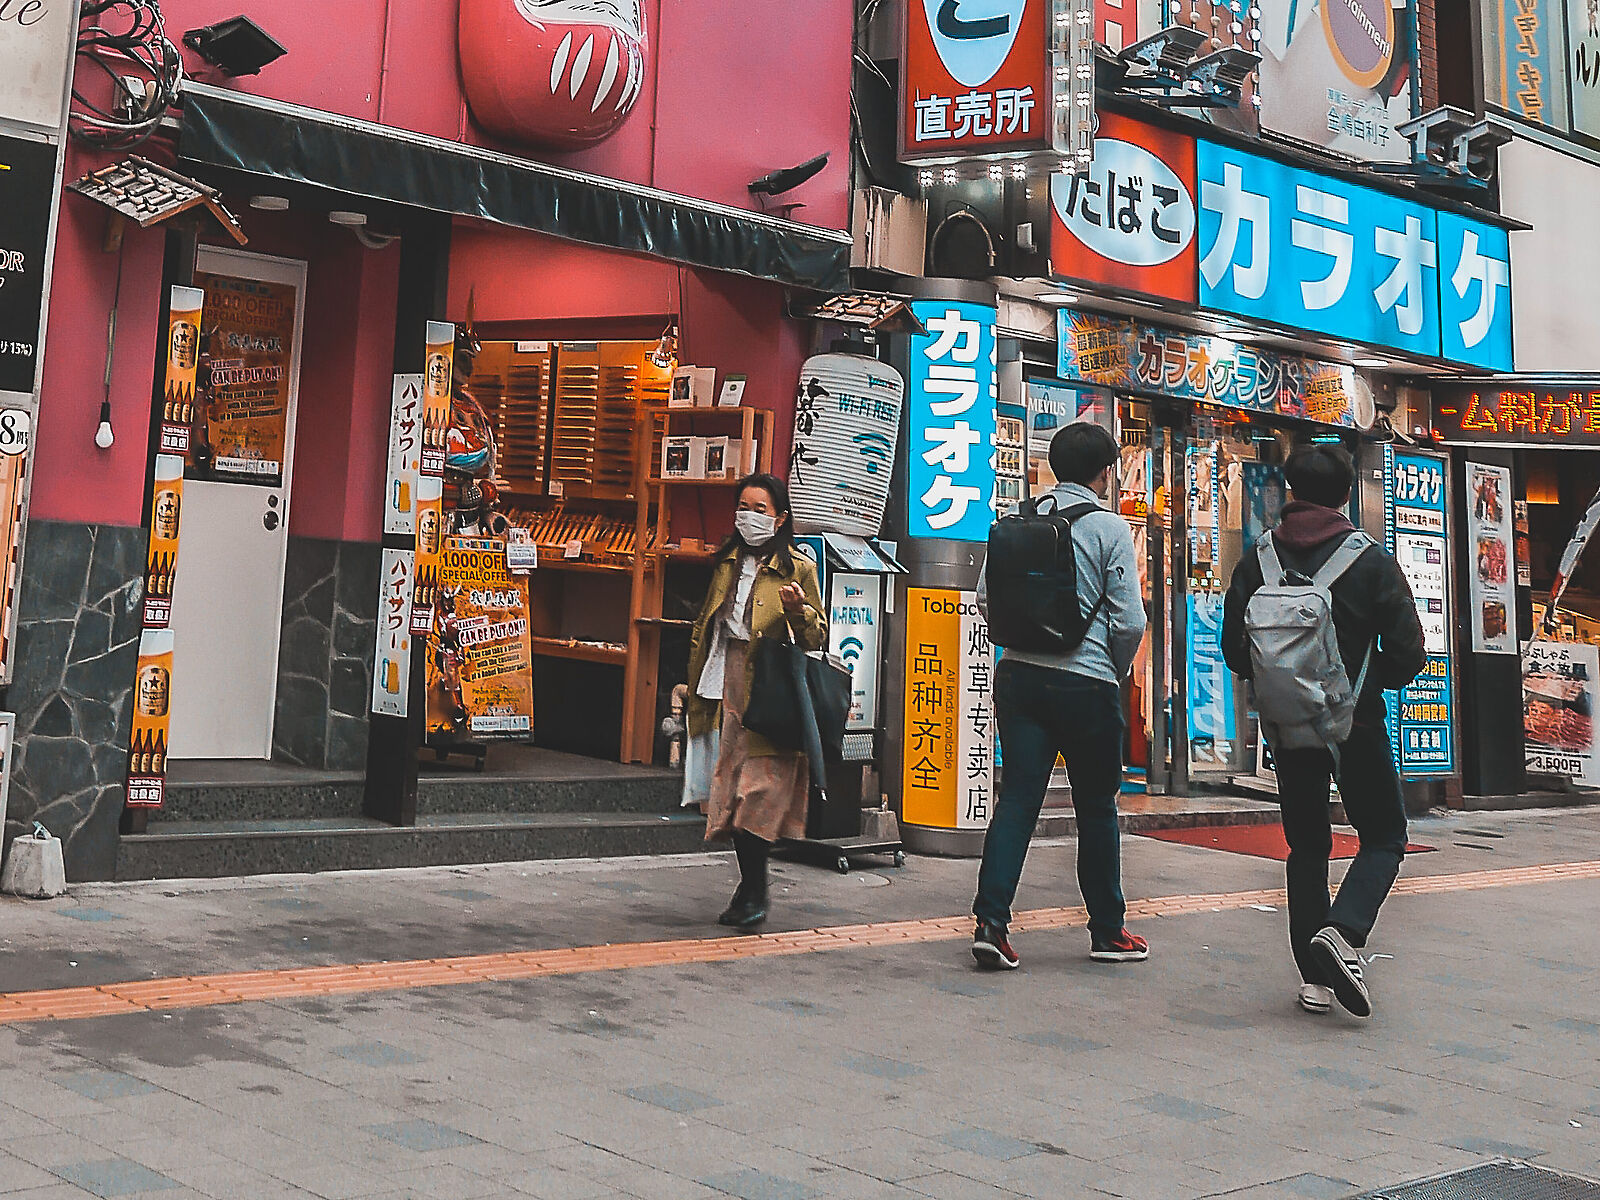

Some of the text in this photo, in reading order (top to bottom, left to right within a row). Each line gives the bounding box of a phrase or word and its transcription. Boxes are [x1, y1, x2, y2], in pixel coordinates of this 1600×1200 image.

[914, 86, 1036, 142] 直売所
[1066, 170, 1180, 244] たばこ
[1199, 162, 1510, 349] カラオケ
[1137, 334, 1300, 406] カラオケランド
[399, 382, 419, 470] ハイサワー
[919, 309, 981, 530] カラオケ
[1028, 398, 1067, 417] MEVIUS
[1396, 462, 1442, 504] カラオケ
[442, 569, 480, 581] SPECIAL
[388, 559, 407, 649] ハイサワー
[921, 596, 978, 616] Tobac
[460, 629, 476, 645] CAN
[478, 626, 488, 641] BE
[490, 622, 507, 640] PUT
[1419, 661, 1447, 677] み自由
[911, 642, 943, 791] 品种齐全
[966, 622, 990, 821] 烟草专卖店
[1402, 703, 1447, 721] 24時間営業
[943, 717, 954, 770] available
